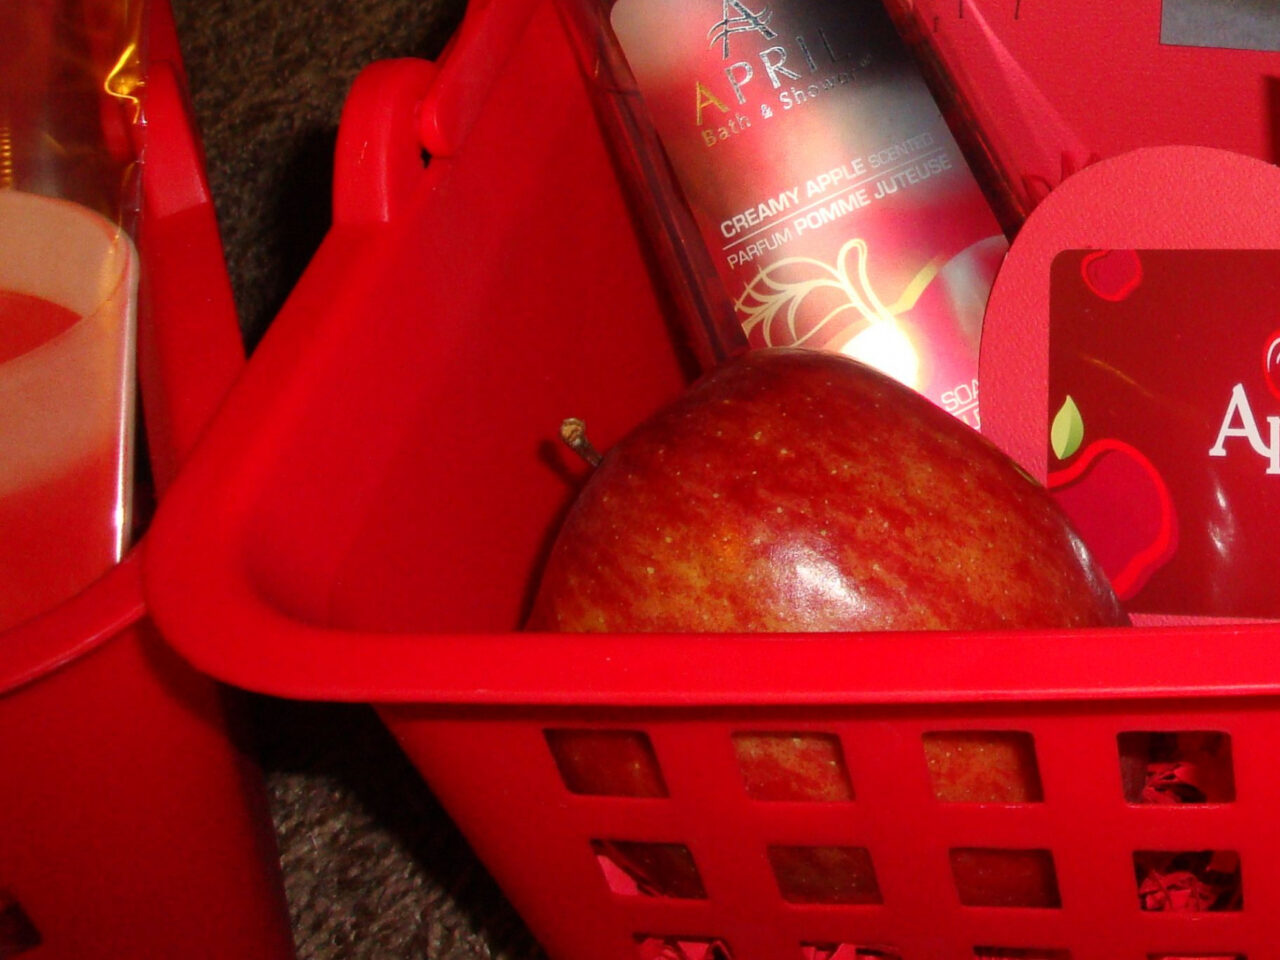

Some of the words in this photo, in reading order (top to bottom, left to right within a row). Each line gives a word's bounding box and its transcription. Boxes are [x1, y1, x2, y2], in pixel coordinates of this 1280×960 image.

[696, 28, 852, 126] APRIL
[701, 112, 751, 147] Bath
[760, 103, 774, 120] &
[779, 68, 858, 111] Shower
[720, 187, 800, 239] CREAMY
[806, 158, 867, 198] APPLE
[868, 132, 935, 169] SCENTED
[726, 227, 793, 270] PARFUM
[793, 189, 872, 237] POMME
[874, 154, 953, 200] JUTEUSE
